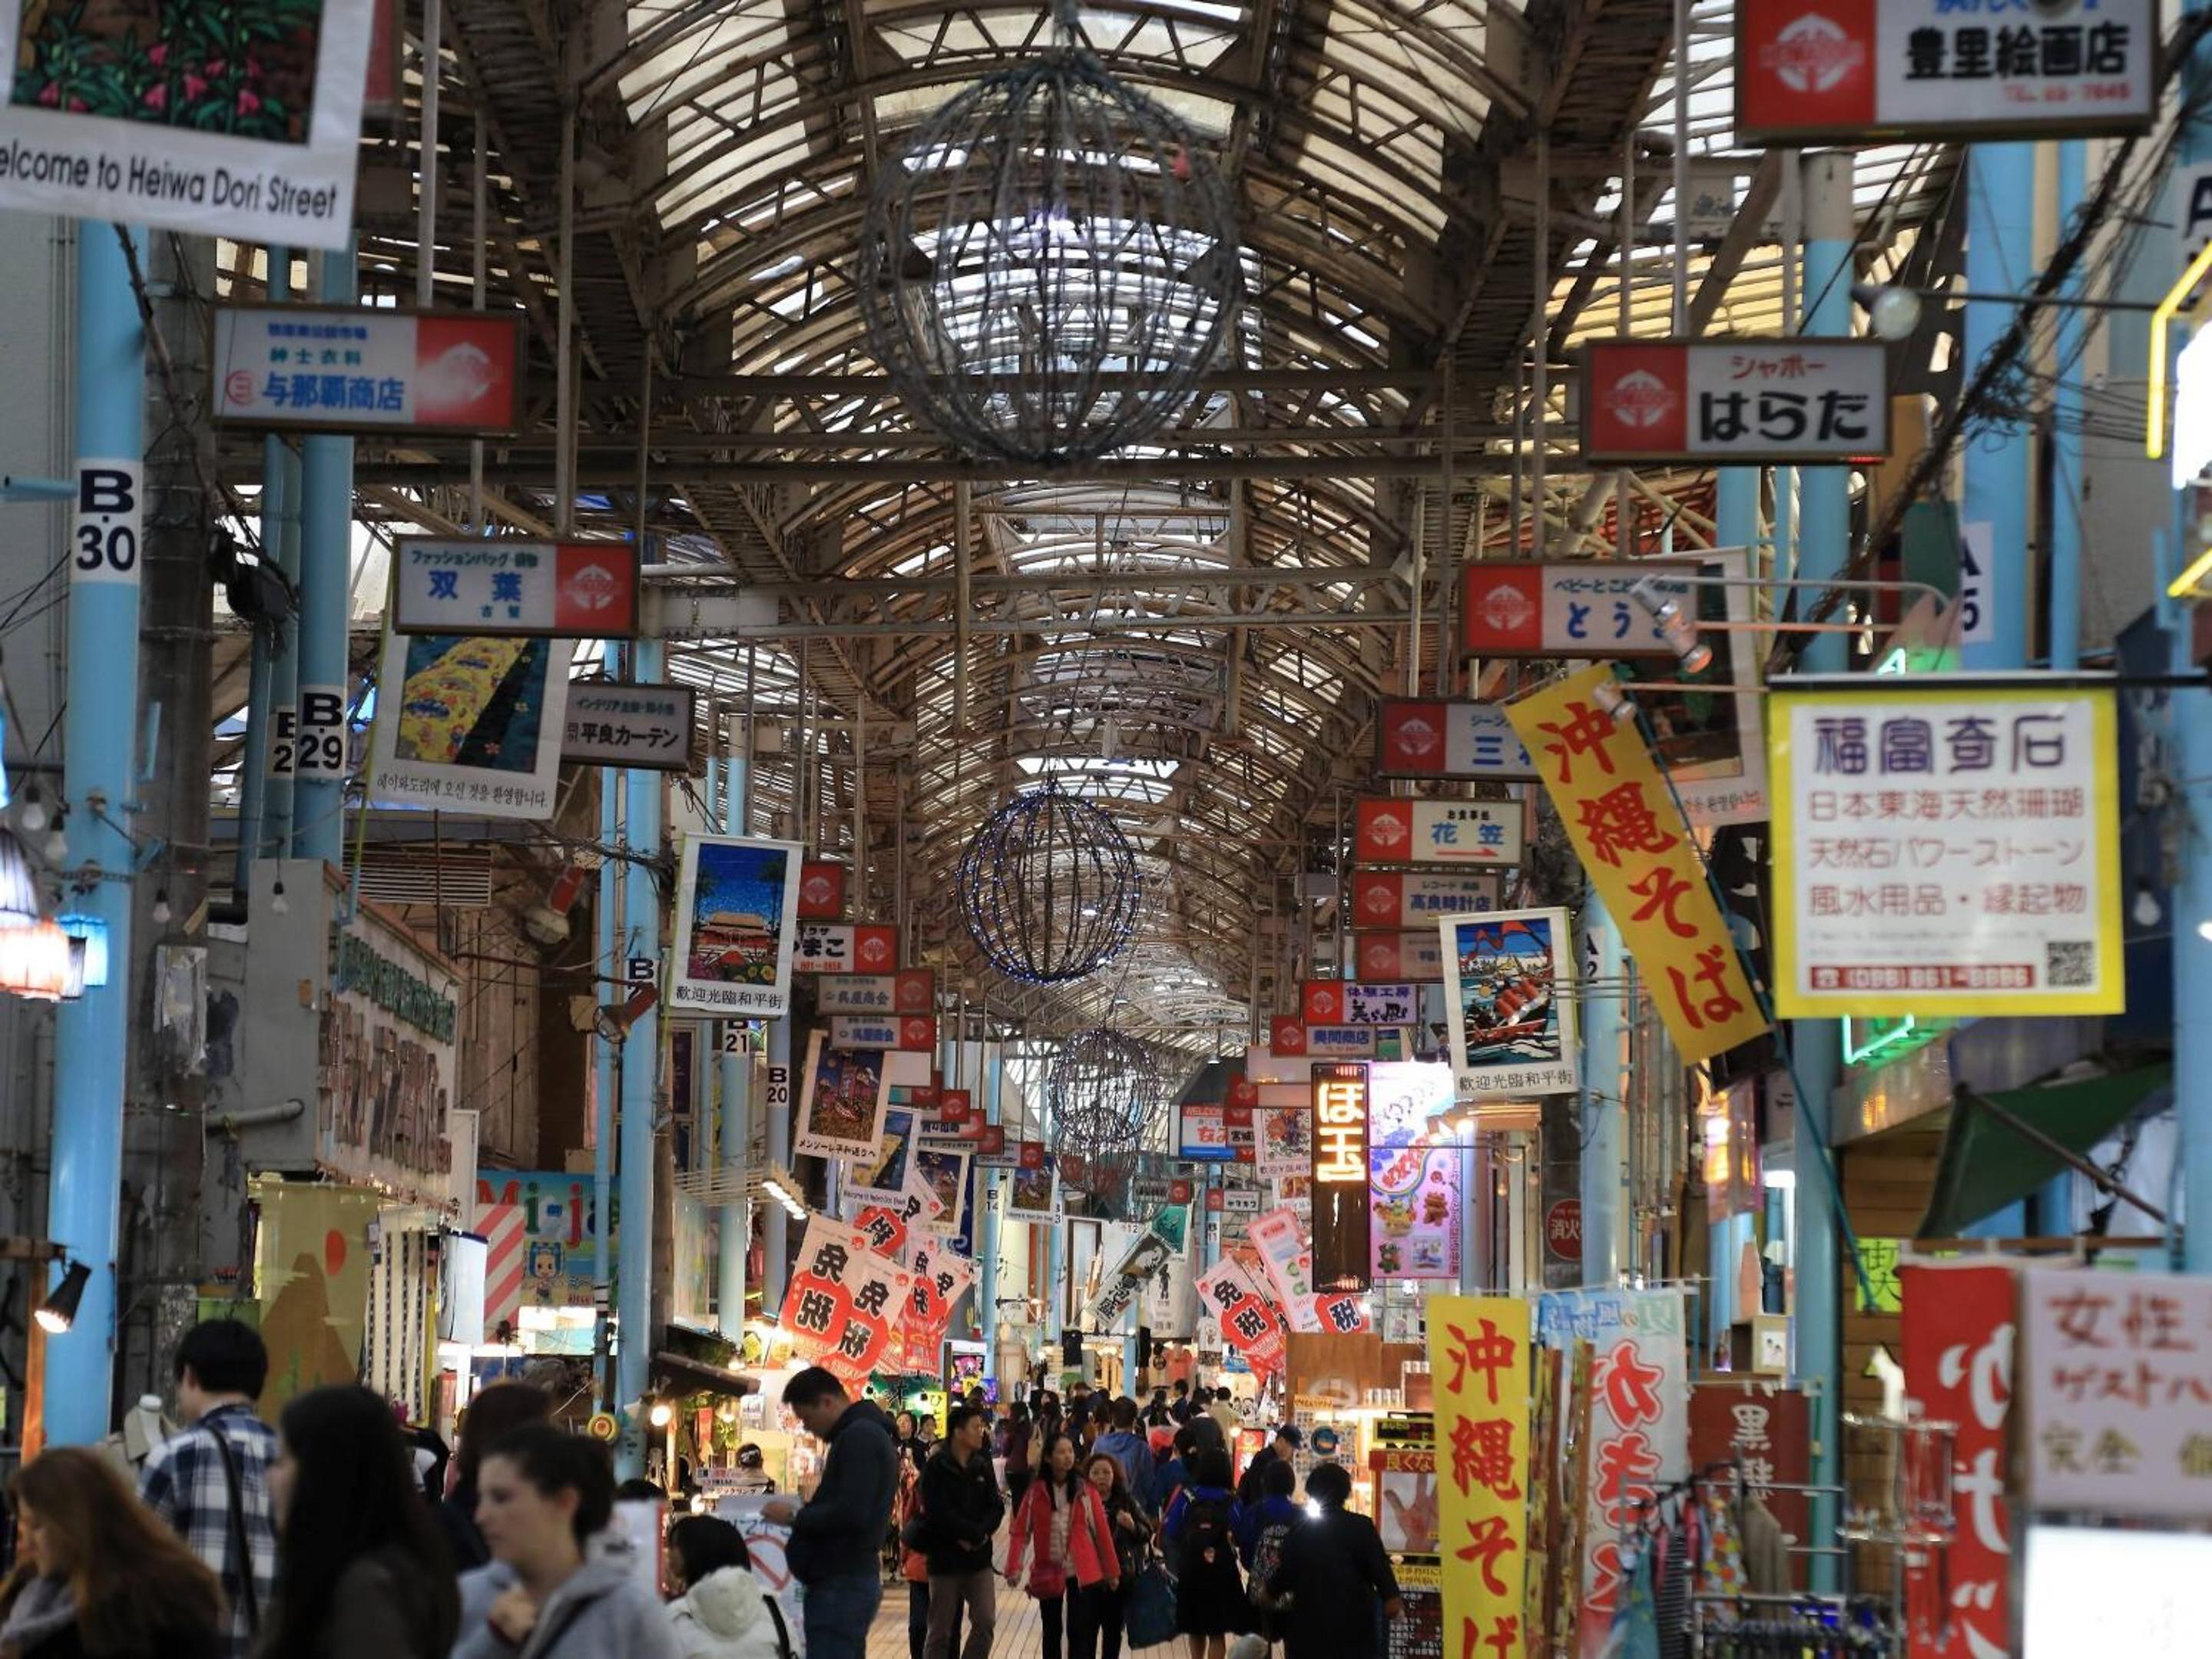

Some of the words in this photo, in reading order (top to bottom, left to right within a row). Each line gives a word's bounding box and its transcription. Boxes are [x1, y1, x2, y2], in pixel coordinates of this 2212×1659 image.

[1906, 21, 2130, 81] 豊里絵画店
[0, 140, 89, 187] elcome
[97, 153, 121, 191] to
[127, 154, 206, 204] Heiwa
[213, 166, 262, 210] Dori
[267, 174, 338, 220] Street
[262, 372, 405, 412] 与那覇商店
[80, 469, 134, 513] B
[77, 525, 136, 571] 30
[302, 693, 343, 727] B
[581, 722, 679, 748] 平良カーテン
[1472, 735, 1532, 766] 三
[299, 736, 343, 769] 29
[1431, 823, 1505, 845] 花笠
[1537, 701, 1744, 1029] 沖縄そば
[1808, 836, 2085, 869] 天然石パワーストーン
[628, 958, 654, 980] B
[725, 1034, 749, 1052] 21
[769, 1067, 787, 1083] B
[768, 1087, 788, 1104] 20
[1551, 1218, 1580, 1240] 消火
